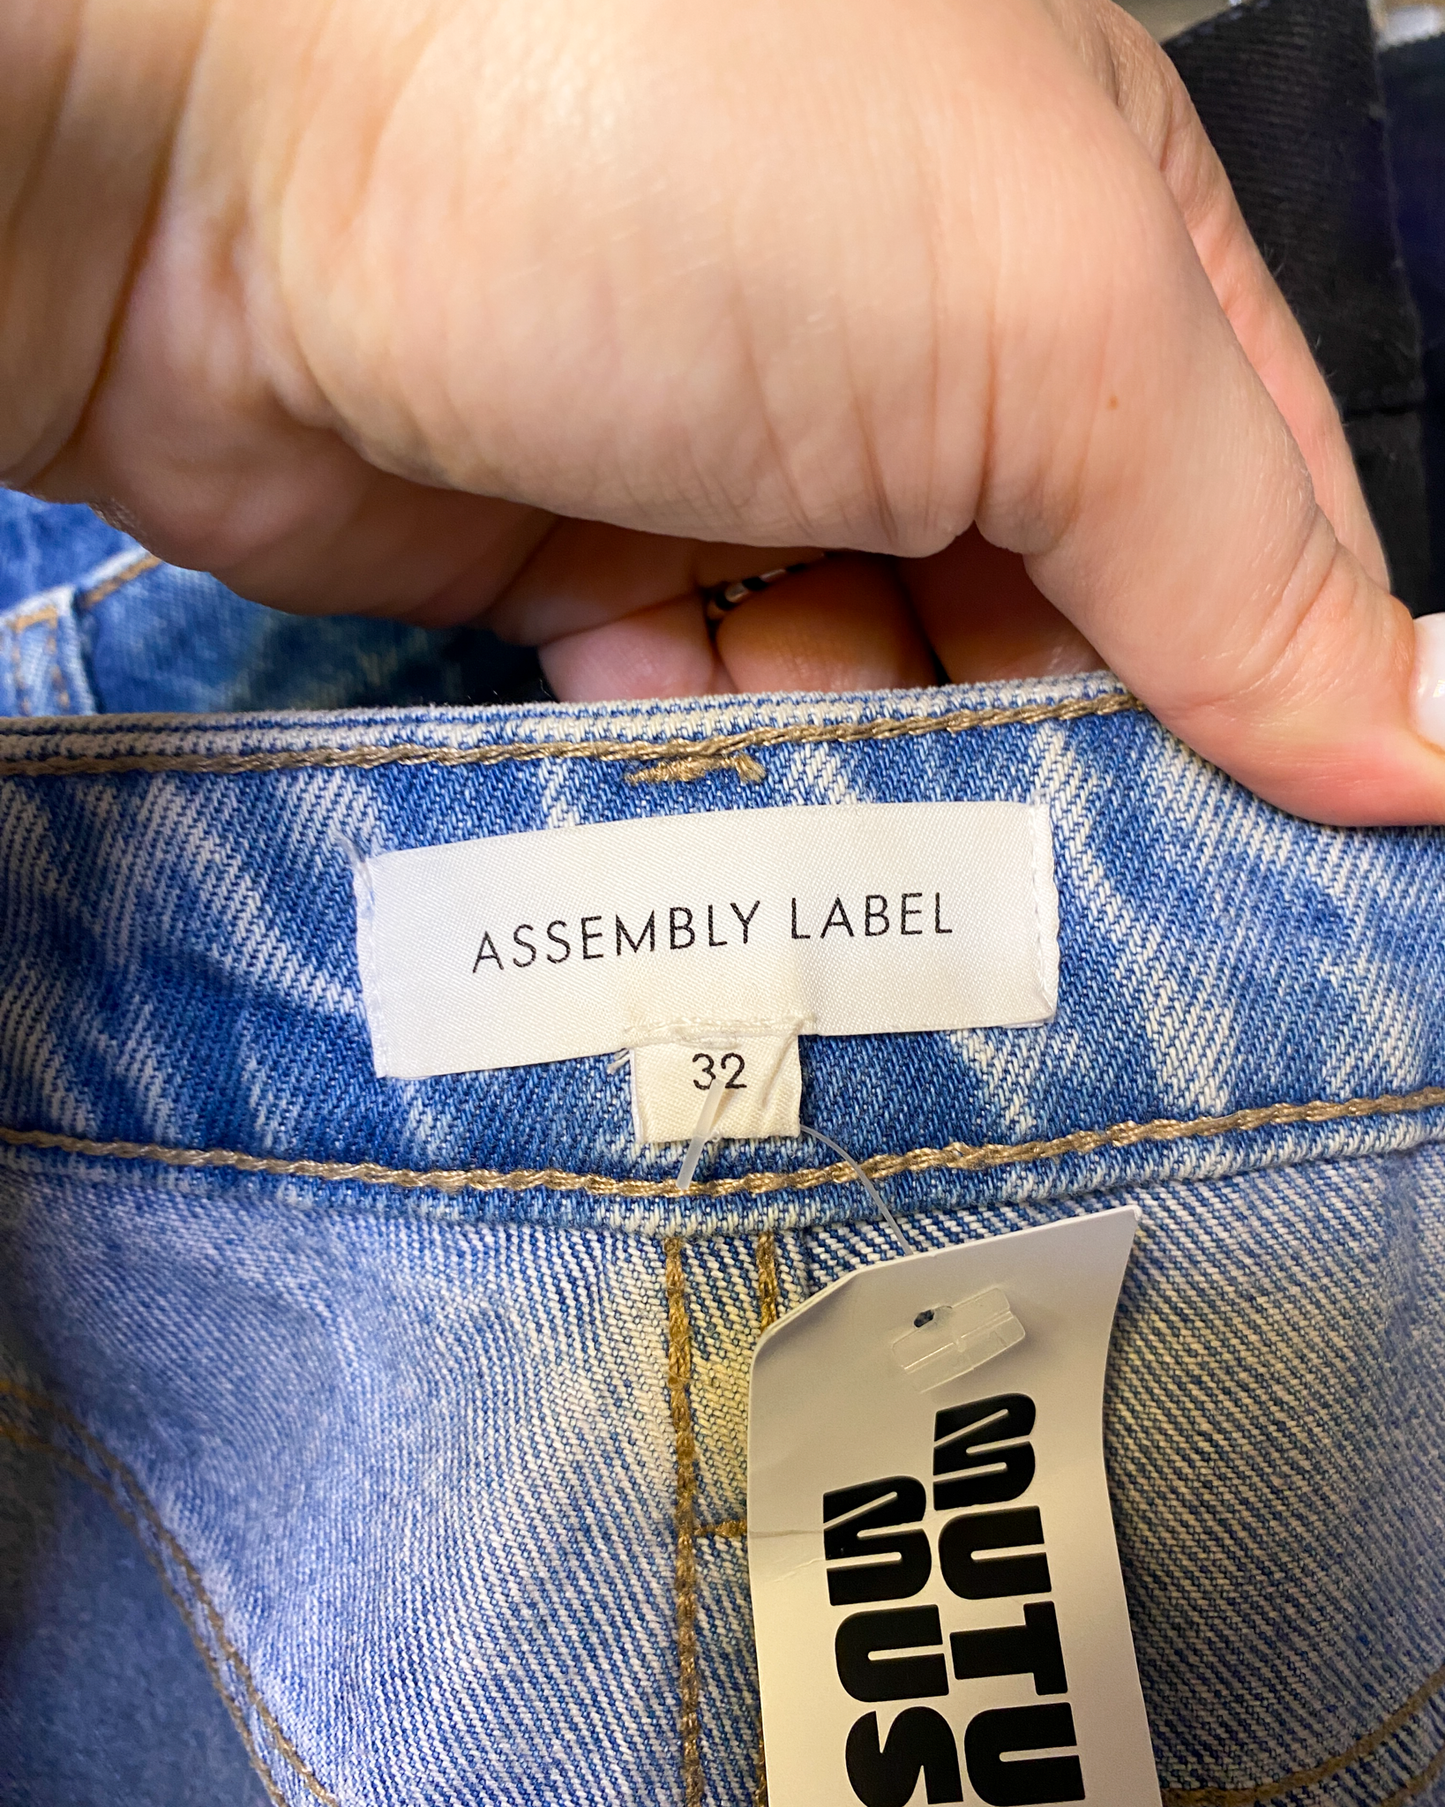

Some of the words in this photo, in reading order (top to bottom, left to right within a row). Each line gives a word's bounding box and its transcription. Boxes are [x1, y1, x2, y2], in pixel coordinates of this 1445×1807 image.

[472, 900, 761, 974] ASSEMBLY
[791, 892, 954, 940] LABEL
[692, 1052, 748, 1091] 32
